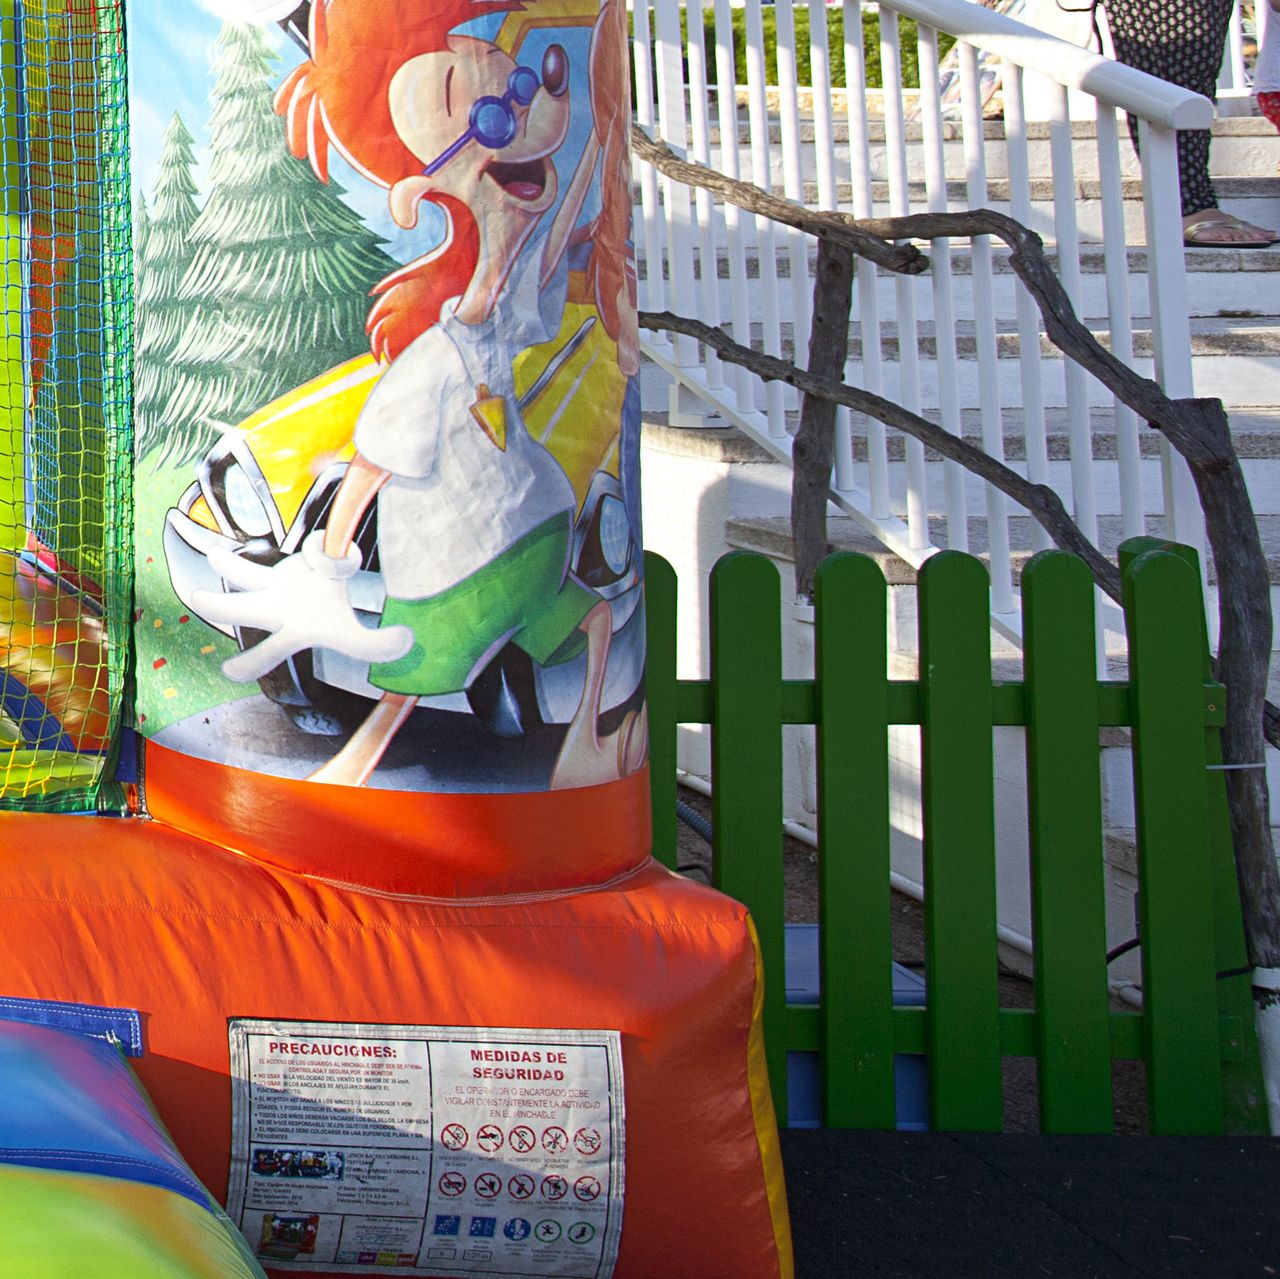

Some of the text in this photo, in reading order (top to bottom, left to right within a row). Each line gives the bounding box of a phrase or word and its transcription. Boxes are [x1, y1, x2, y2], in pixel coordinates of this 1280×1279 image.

[269, 1042, 397, 1058] PRECAUCIONES:
[470, 1049, 567, 1064] MEDIDAS DE
[473, 1067, 564, 1081] SEGURIDAD
[467, 1086, 510, 1095] OPEROR
[519, 1088, 566, 1097] ENCARGADO
[445, 1097, 474, 1105] VIGILAR
[490, 1109, 500, 1117] EN
